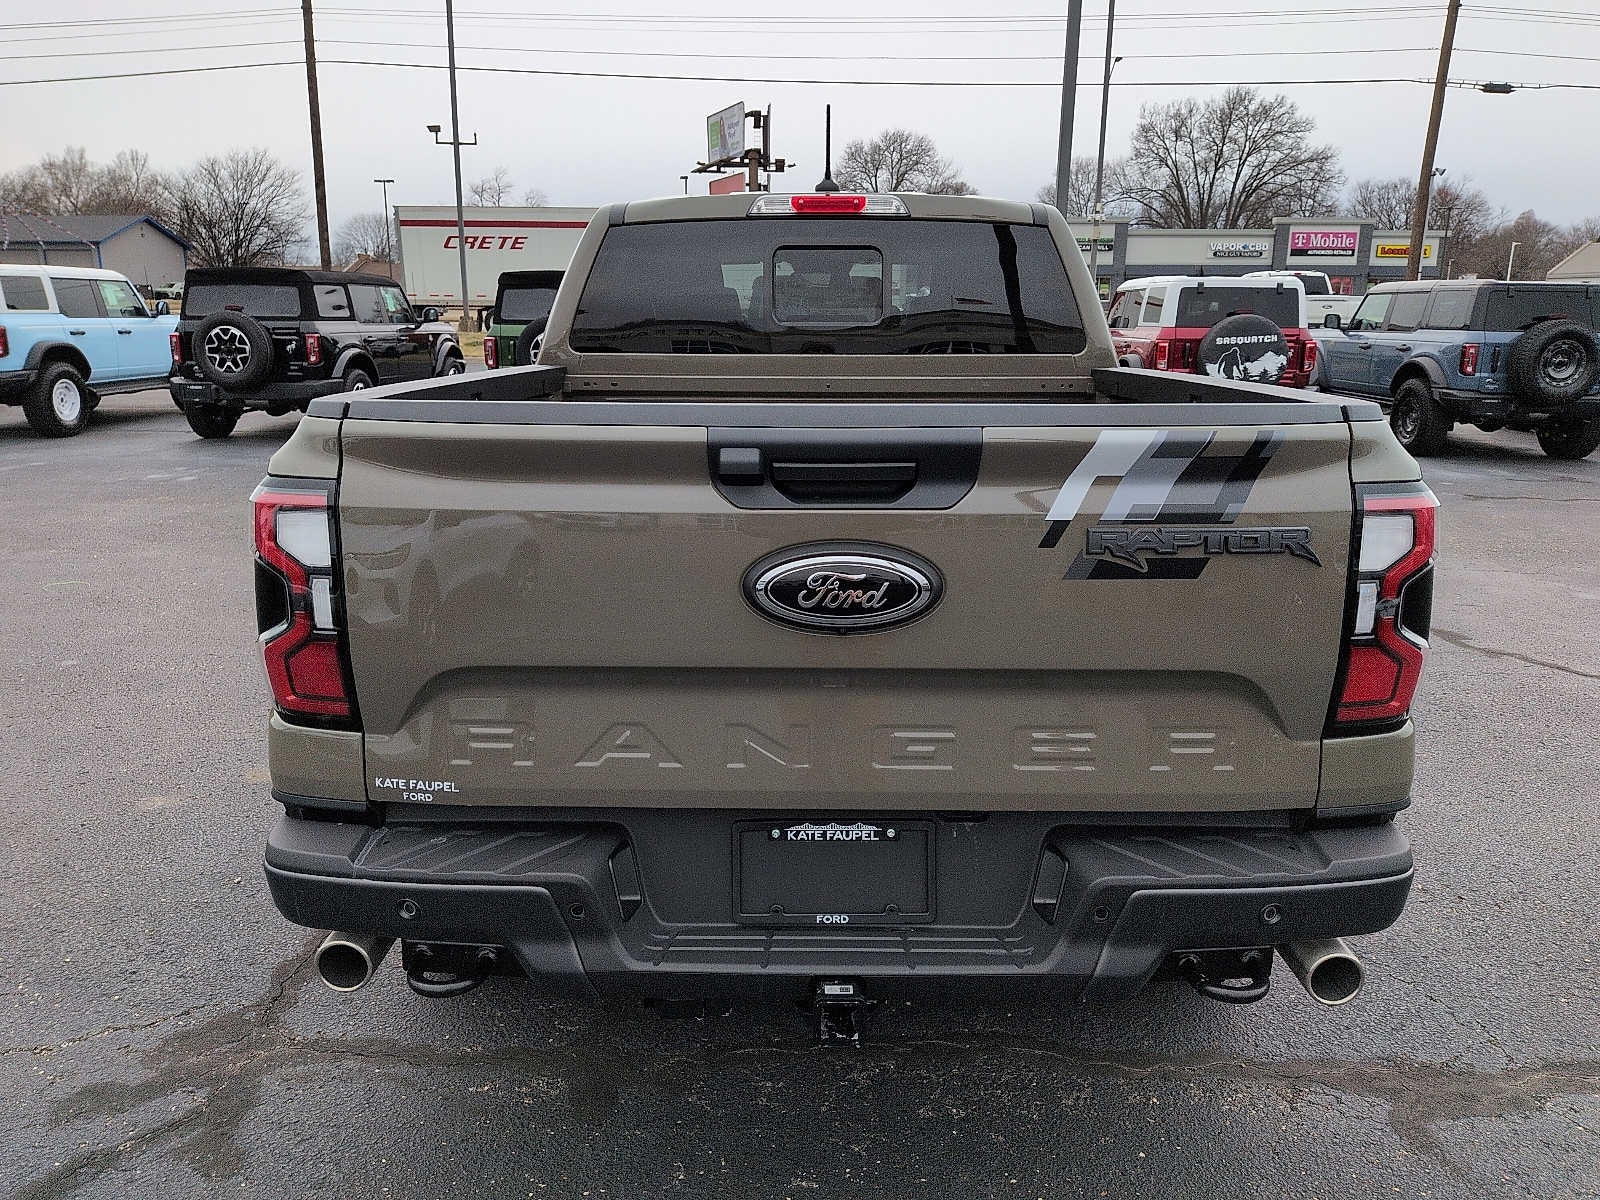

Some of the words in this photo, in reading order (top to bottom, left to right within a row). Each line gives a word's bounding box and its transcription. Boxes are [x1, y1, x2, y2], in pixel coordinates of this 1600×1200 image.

[444, 236, 528, 249] CRETE
[1210, 242, 1243, 250] VAPOR
[1249, 242, 1269, 250] CBD
[1215, 334, 1278, 345] SASQUATCH
[1086, 526, 1322, 572] RAPTOR
[797, 571, 890, 608] Ford
[448, 718, 1236, 771] RANGER
[375, 777, 407, 789] KATE
[409, 779, 460, 793] FAUPEL
[402, 791, 433, 802] FORD
[787, 830, 823, 841] KATE
[826, 830, 879, 841] FAUPEL
[816, 915, 849, 924] FORD
